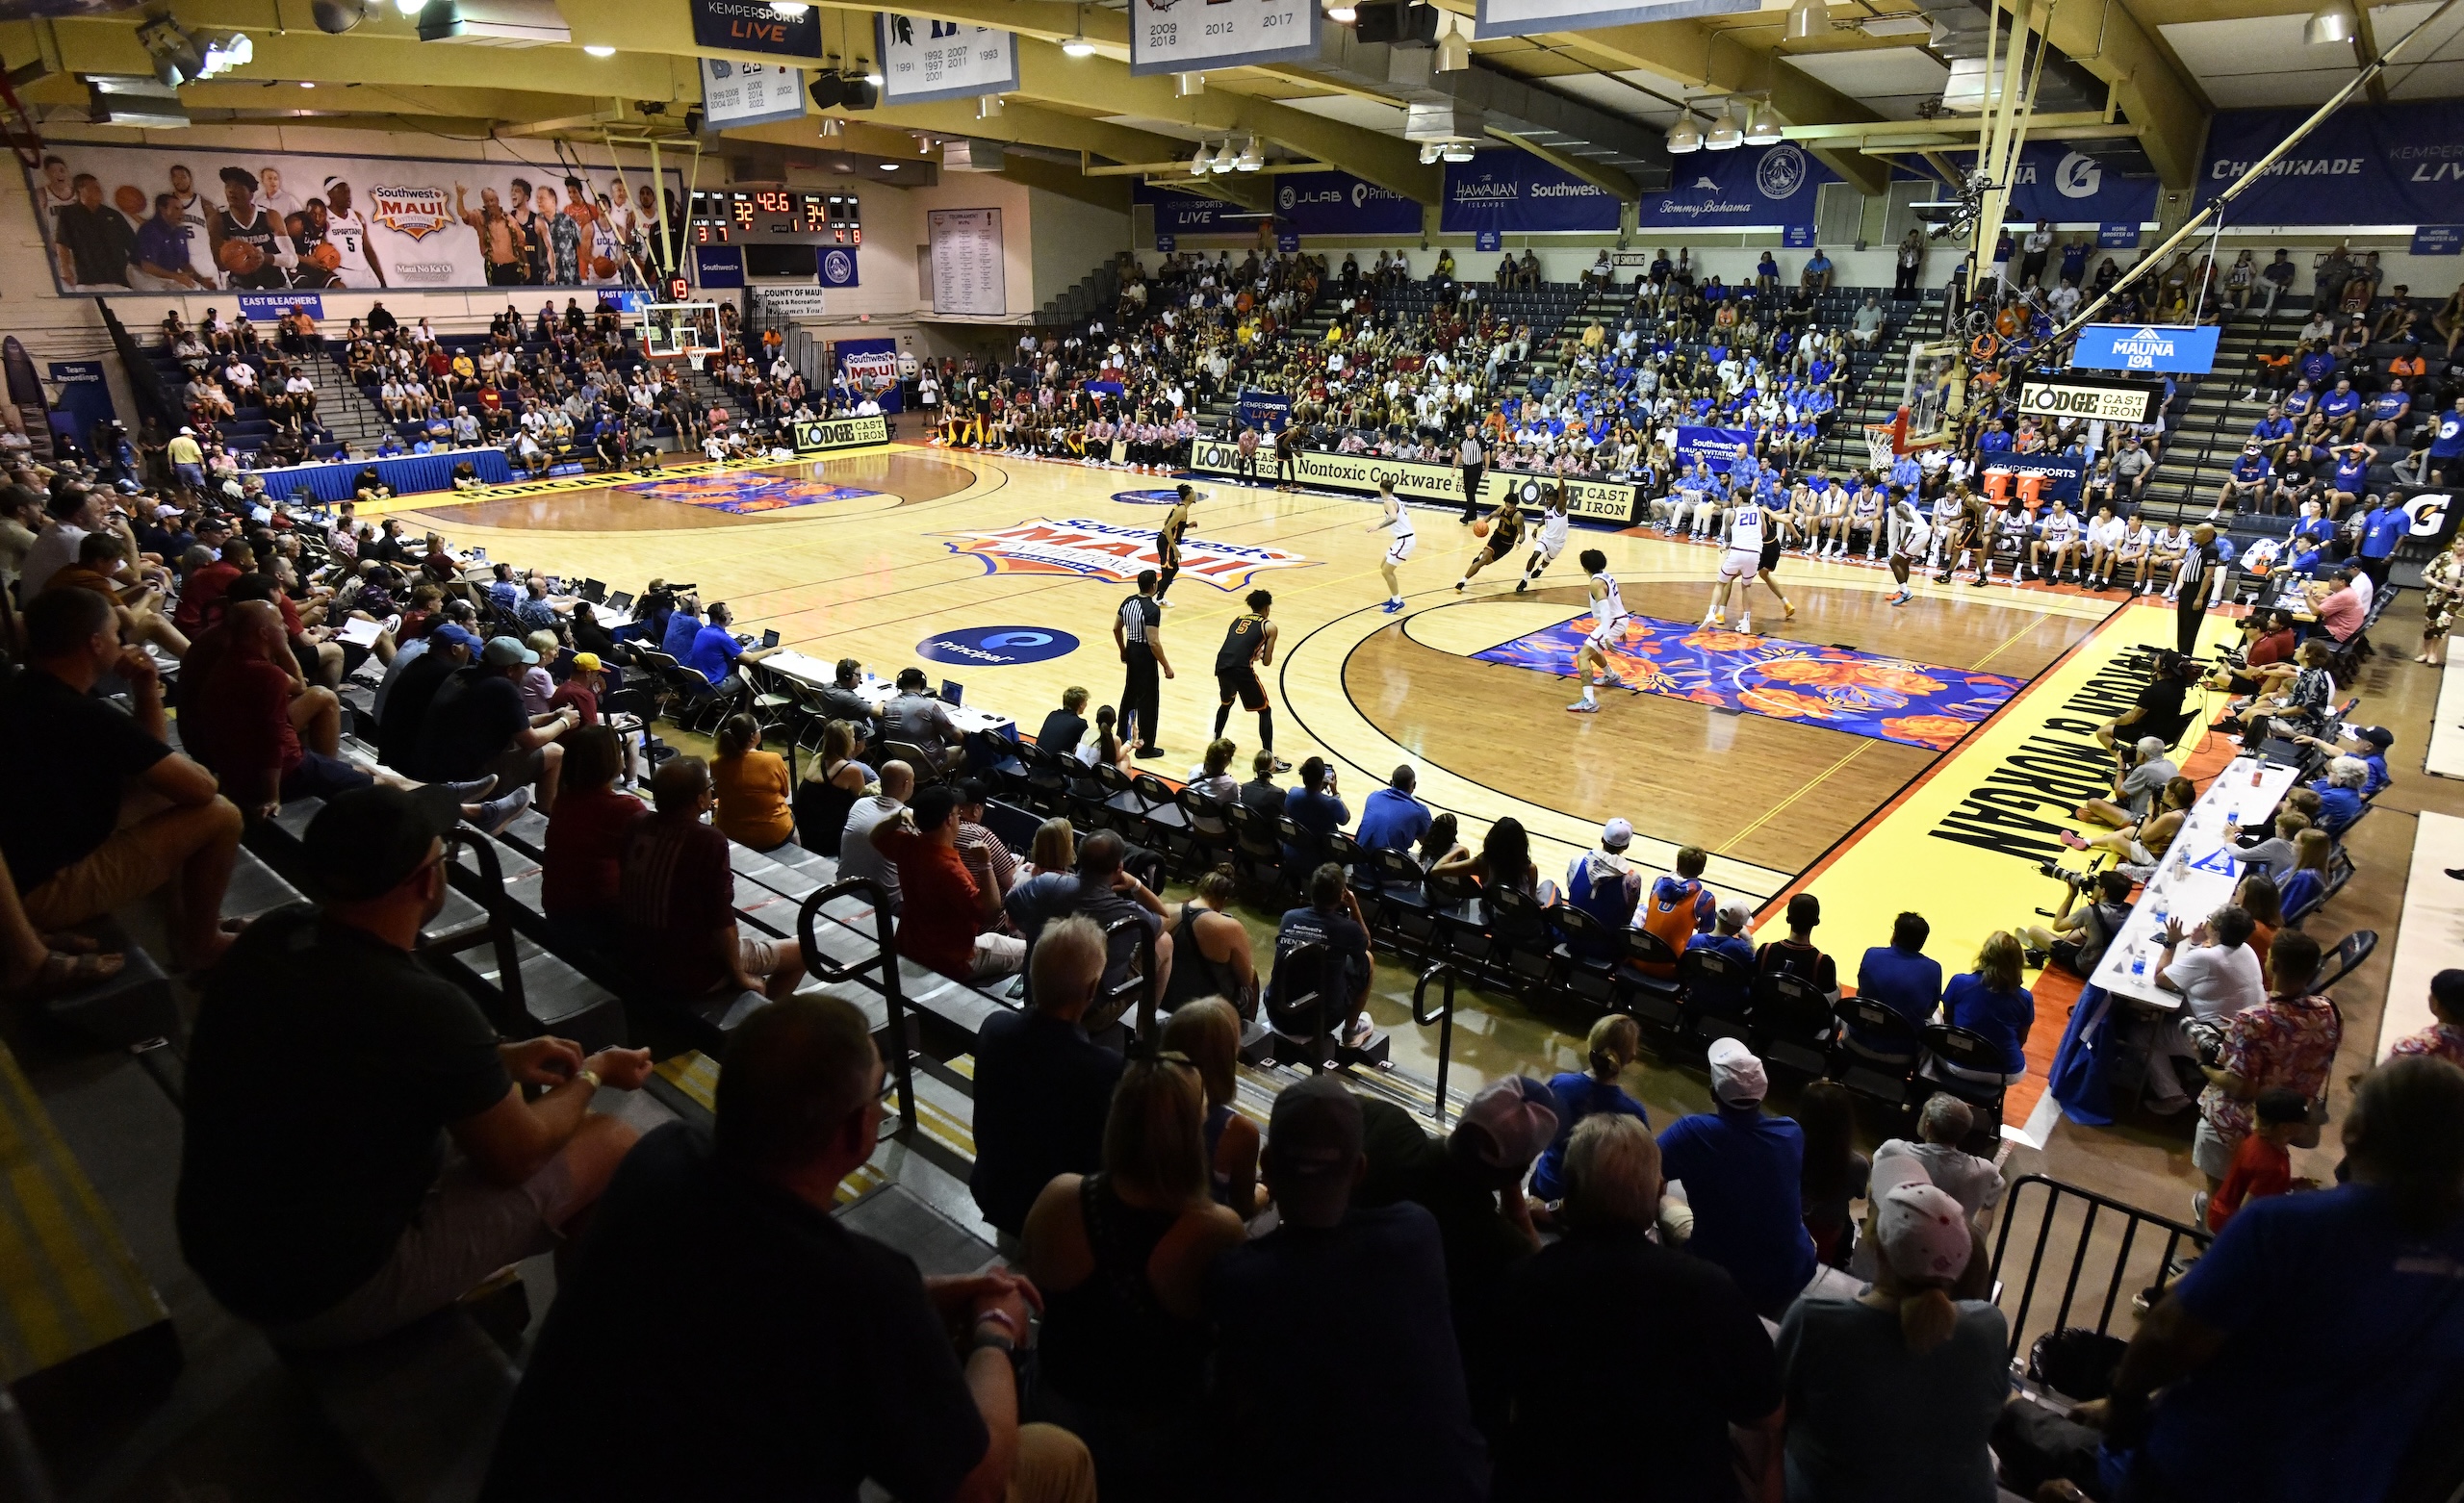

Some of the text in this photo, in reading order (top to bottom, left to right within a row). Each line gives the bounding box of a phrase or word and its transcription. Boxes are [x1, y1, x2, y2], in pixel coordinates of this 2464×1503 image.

[707, 2, 805, 24] KEMPERSPORTS
[1263, 13, 1294, 28] 2017
[732, 20, 787, 42] LIVE
[1150, 23, 1177, 36] 2009
[1205, 22, 1234, 36] 2012
[1150, 36, 1176, 47] 2018
[924, 46, 967, 61] 1992 2007
[979, 49, 998, 61] 1993
[896, 63, 914, 72] 1991
[925, 58, 966, 71] 1997 2011
[925, 71, 942, 82] 2001
[747, 81, 762, 90] 2000
[777, 86, 792, 96] 2002
[710, 88, 739, 100] 1999 2008
[748, 90, 763, 100] 2014
[710, 97, 740, 109] 2004 2016
[749, 99, 764, 109] 2022
[2390, 144, 2464, 160] KEMPER
[2055, 150, 2102, 199] G
[2212, 158, 2365, 180] CHMINADE
[2411, 162, 2464, 182] LIV
[376, 187, 435, 199] Southwest
[1369, 187, 1405, 202] Princip
[1454, 180, 1518, 204] HAWAIIAN
[1530, 181, 1601, 198] Southwest
[757, 192, 789, 212] 42.6
[1167, 199, 1223, 209] KEMPERSPORTS
[1296, 191, 1342, 204] JLAB
[380, 199, 445, 217] MAUI
[733, 202, 754, 221] 32
[807, 205, 825, 223] 34
[1659, 199, 1752, 217] Tommy Bahama
[1178, 211, 1212, 224] LIVE
[793, 218, 799, 232] 1
[699, 227, 707, 242] 3
[719, 227, 728, 242] 7
[835, 230, 843, 242] 4
[853, 229, 860, 243] 8
[346, 237, 356, 252] 5
[1613, 255, 1645, 266] NO SMOKING
[601, 291, 618, 299] EAST
[673, 279, 687, 298] 19
[764, 289, 793, 297] COUNTY
[243, 295, 318, 306] EAST BLEACHERS
[2112, 341, 2174, 356] MAUNA
[848, 353, 889, 364] Southwest
[2127, 355, 2153, 369] LOA
[57, 373, 99, 384] Recordings
[851, 364, 895, 380] MAUI
[1243, 400, 1288, 412] KEMPERSPORTS
[2021, 385, 2100, 415] LODGE
[2104, 395, 2145, 406] CAST
[1251, 410, 1278, 420] LIVE
[2102, 405, 2143, 418] IRON
[855, 420, 883, 431] CAST
[797, 421, 854, 446] LODGE
[859, 429, 886, 441] IRON
[1692, 439, 1732, 450] Southwest
[1195, 446, 1239, 472] LODG
[1255, 451, 1275, 463] CAS
[1700, 448, 1737, 458] NVITATION
[1258, 464, 1279, 475] RON
[1297, 458, 1452, 493] Nontoxic Cookware
[1509, 479, 1584, 510] LODE
[1587, 487, 1629, 502] CAST
[1585, 500, 1627, 516] IRON
[1739, 512, 1758, 525] 20
[2054, 533, 2066, 542] 23
[997, 543, 1144, 573] INVITATIONAL
[1235, 620, 1252, 635] 5
[933, 639, 1011, 664] Principal
[1927, 735, 2118, 864] MORGAN
